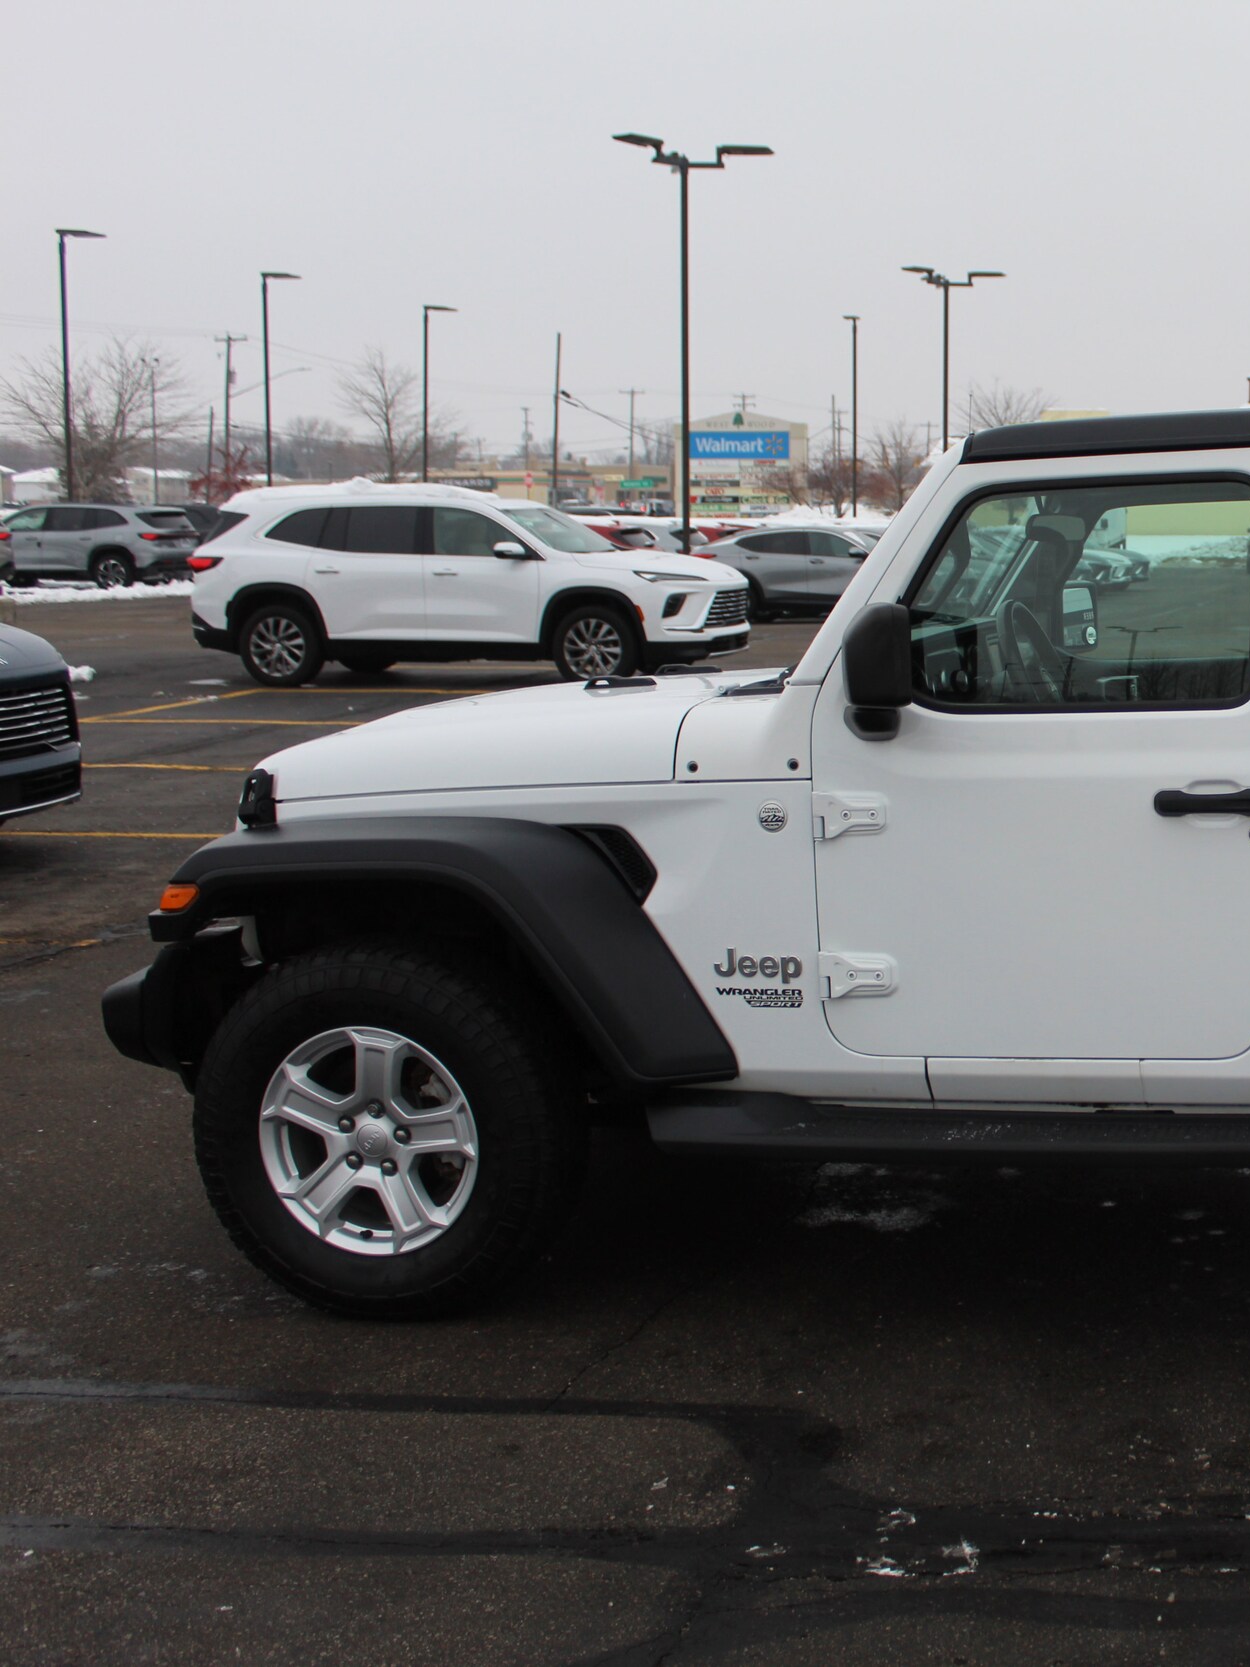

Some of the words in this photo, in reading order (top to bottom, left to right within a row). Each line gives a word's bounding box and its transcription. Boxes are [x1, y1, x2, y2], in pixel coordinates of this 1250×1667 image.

[695, 437, 764, 453] Walmart
[713, 946, 803, 984] Jeep
[716, 987, 803, 996] WRANGLER
